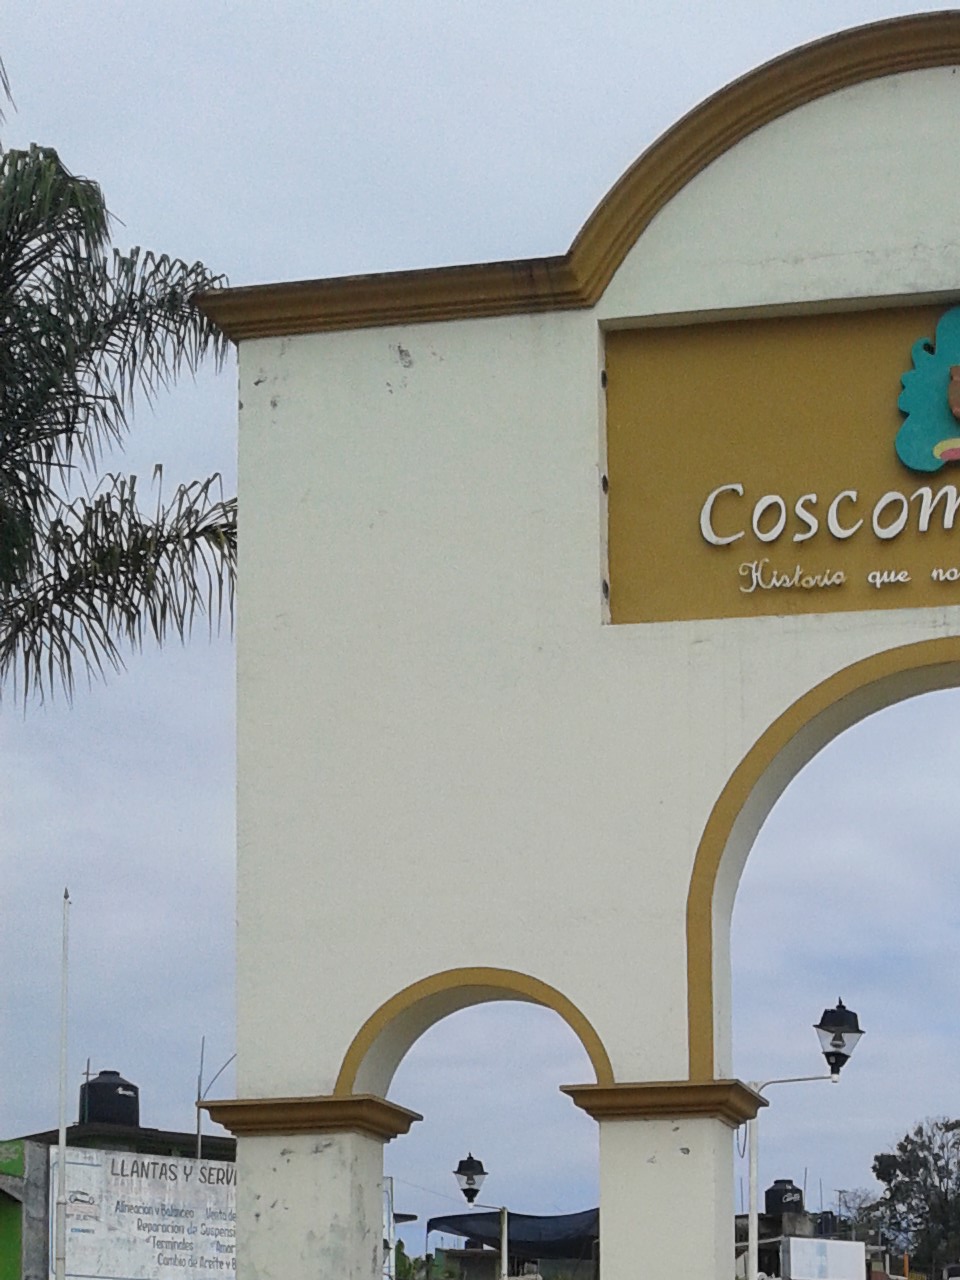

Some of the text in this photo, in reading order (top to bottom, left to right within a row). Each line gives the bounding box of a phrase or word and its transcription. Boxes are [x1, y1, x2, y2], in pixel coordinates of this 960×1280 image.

[738, 558, 848, 593] Historia
[867, 567, 912, 589] que
[111, 1158, 178, 1181] LLANTAS
[183, 1165, 193, 1183] Y
[161, 1203, 195, 1219] Balanceo
[186, 1223, 198, 1235] de
[157, 1252, 187, 1267] Cambio
[187, 1255, 198, 1268] de
